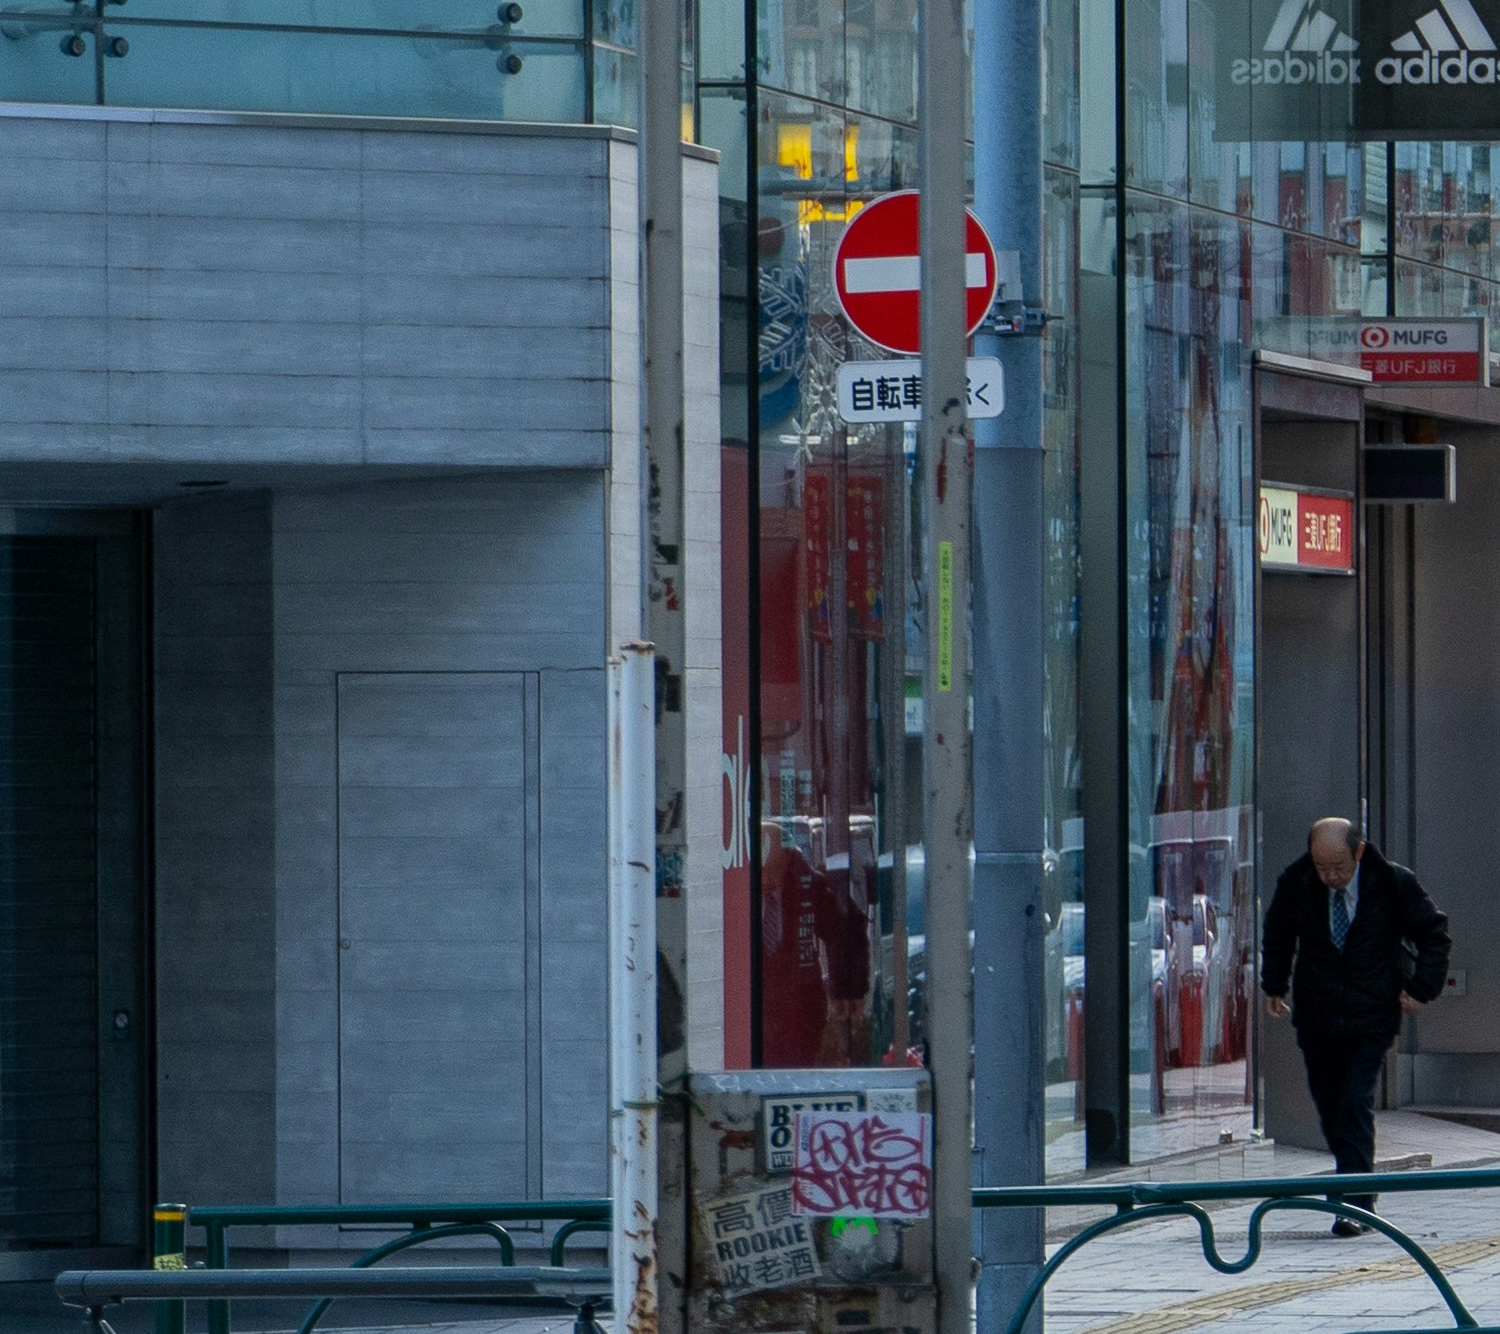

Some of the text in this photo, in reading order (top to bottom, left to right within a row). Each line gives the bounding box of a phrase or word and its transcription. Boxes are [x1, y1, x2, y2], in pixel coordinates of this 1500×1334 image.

[1393, 329, 1448, 346] MUFG
[1361, 358, 1457, 375] 三菱UFJ銀行
[850, 374, 990, 413] 自転車く
[1271, 507, 1293, 548] MUFG
[715, 1227, 809, 1263] ROOKIE
